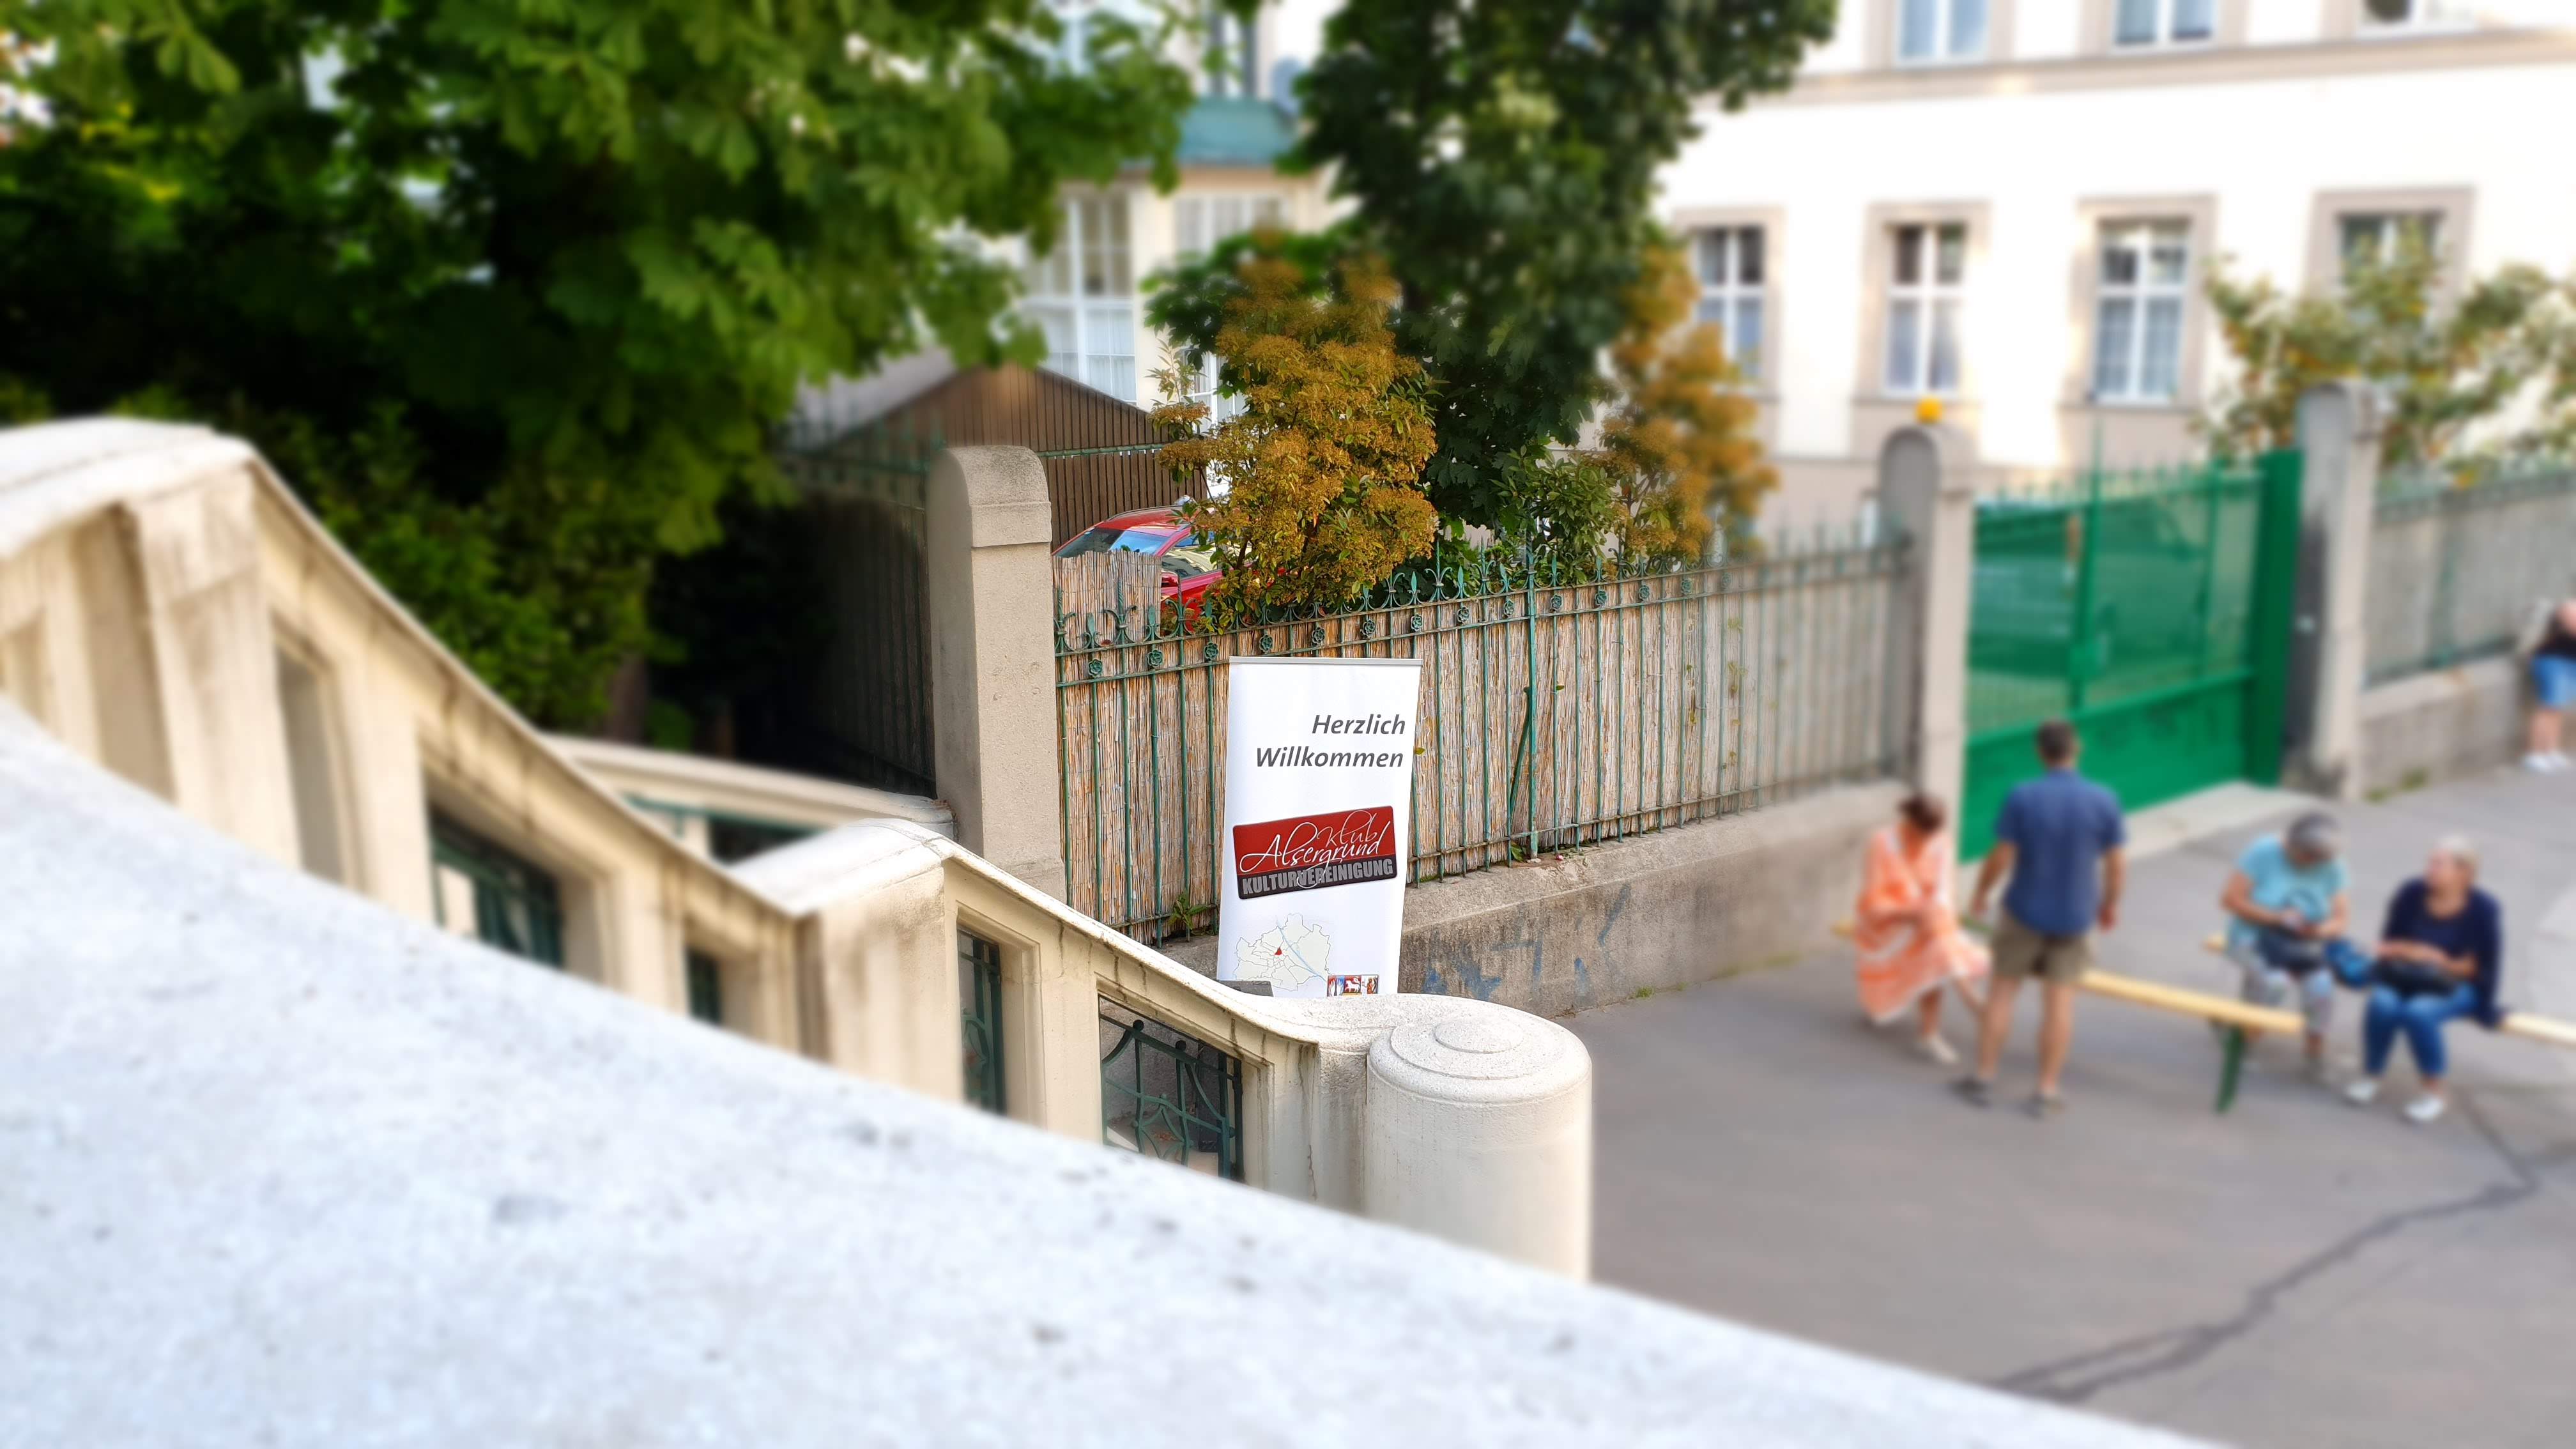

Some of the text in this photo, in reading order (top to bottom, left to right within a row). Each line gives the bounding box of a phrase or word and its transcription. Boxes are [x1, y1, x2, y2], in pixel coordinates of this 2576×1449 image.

[1312, 714, 1406, 735] Herzlich
[1256, 746, 1404, 767] Willkommen
[1317, 809, 1377, 847] Klub
[1239, 821, 1391, 889] Alsergrund
[1242, 858, 1393, 895] KULTURVEREINIGUNG
